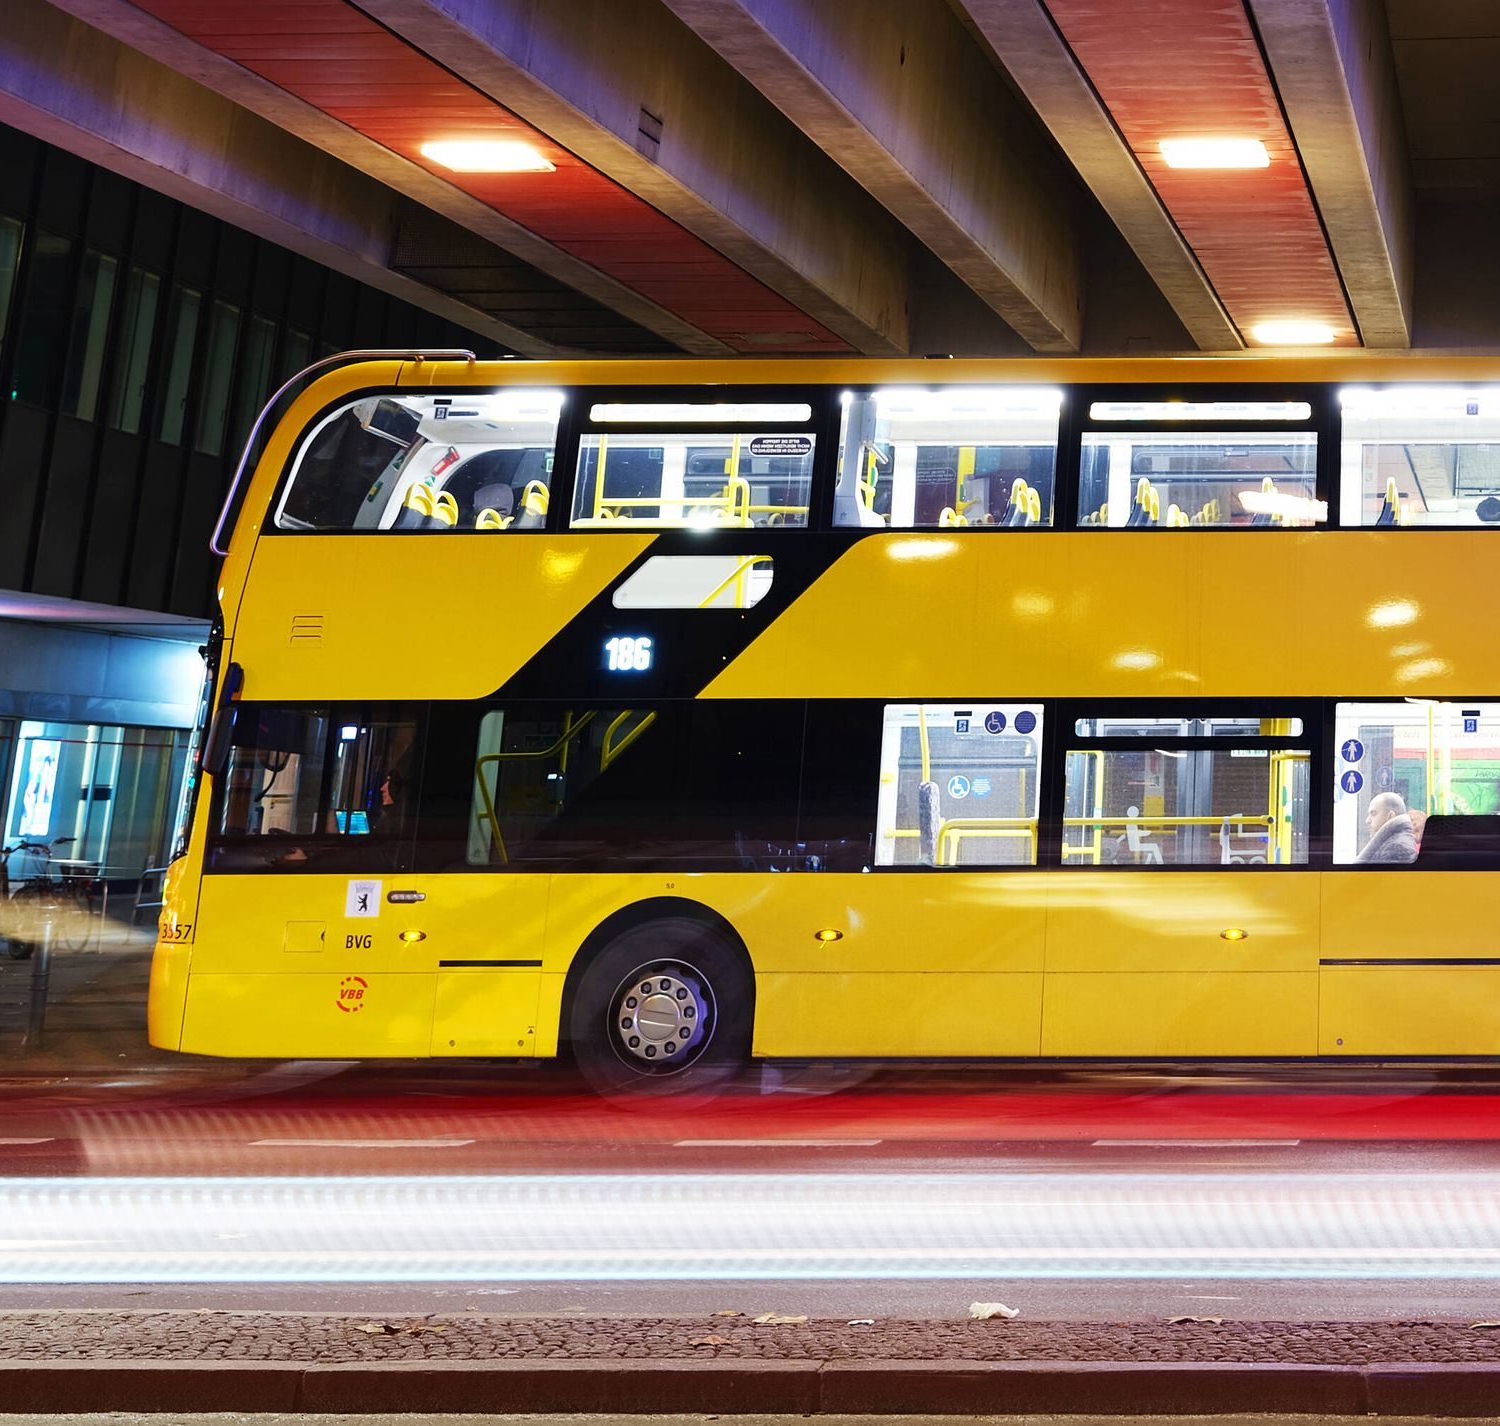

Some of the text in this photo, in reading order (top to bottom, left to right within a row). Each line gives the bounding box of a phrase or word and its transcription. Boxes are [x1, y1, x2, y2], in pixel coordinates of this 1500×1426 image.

[605, 637, 652, 671] 186
[161, 924, 192, 940] 3557
[345, 934, 372, 949] BVG
[339, 988, 364, 1000] VBB
